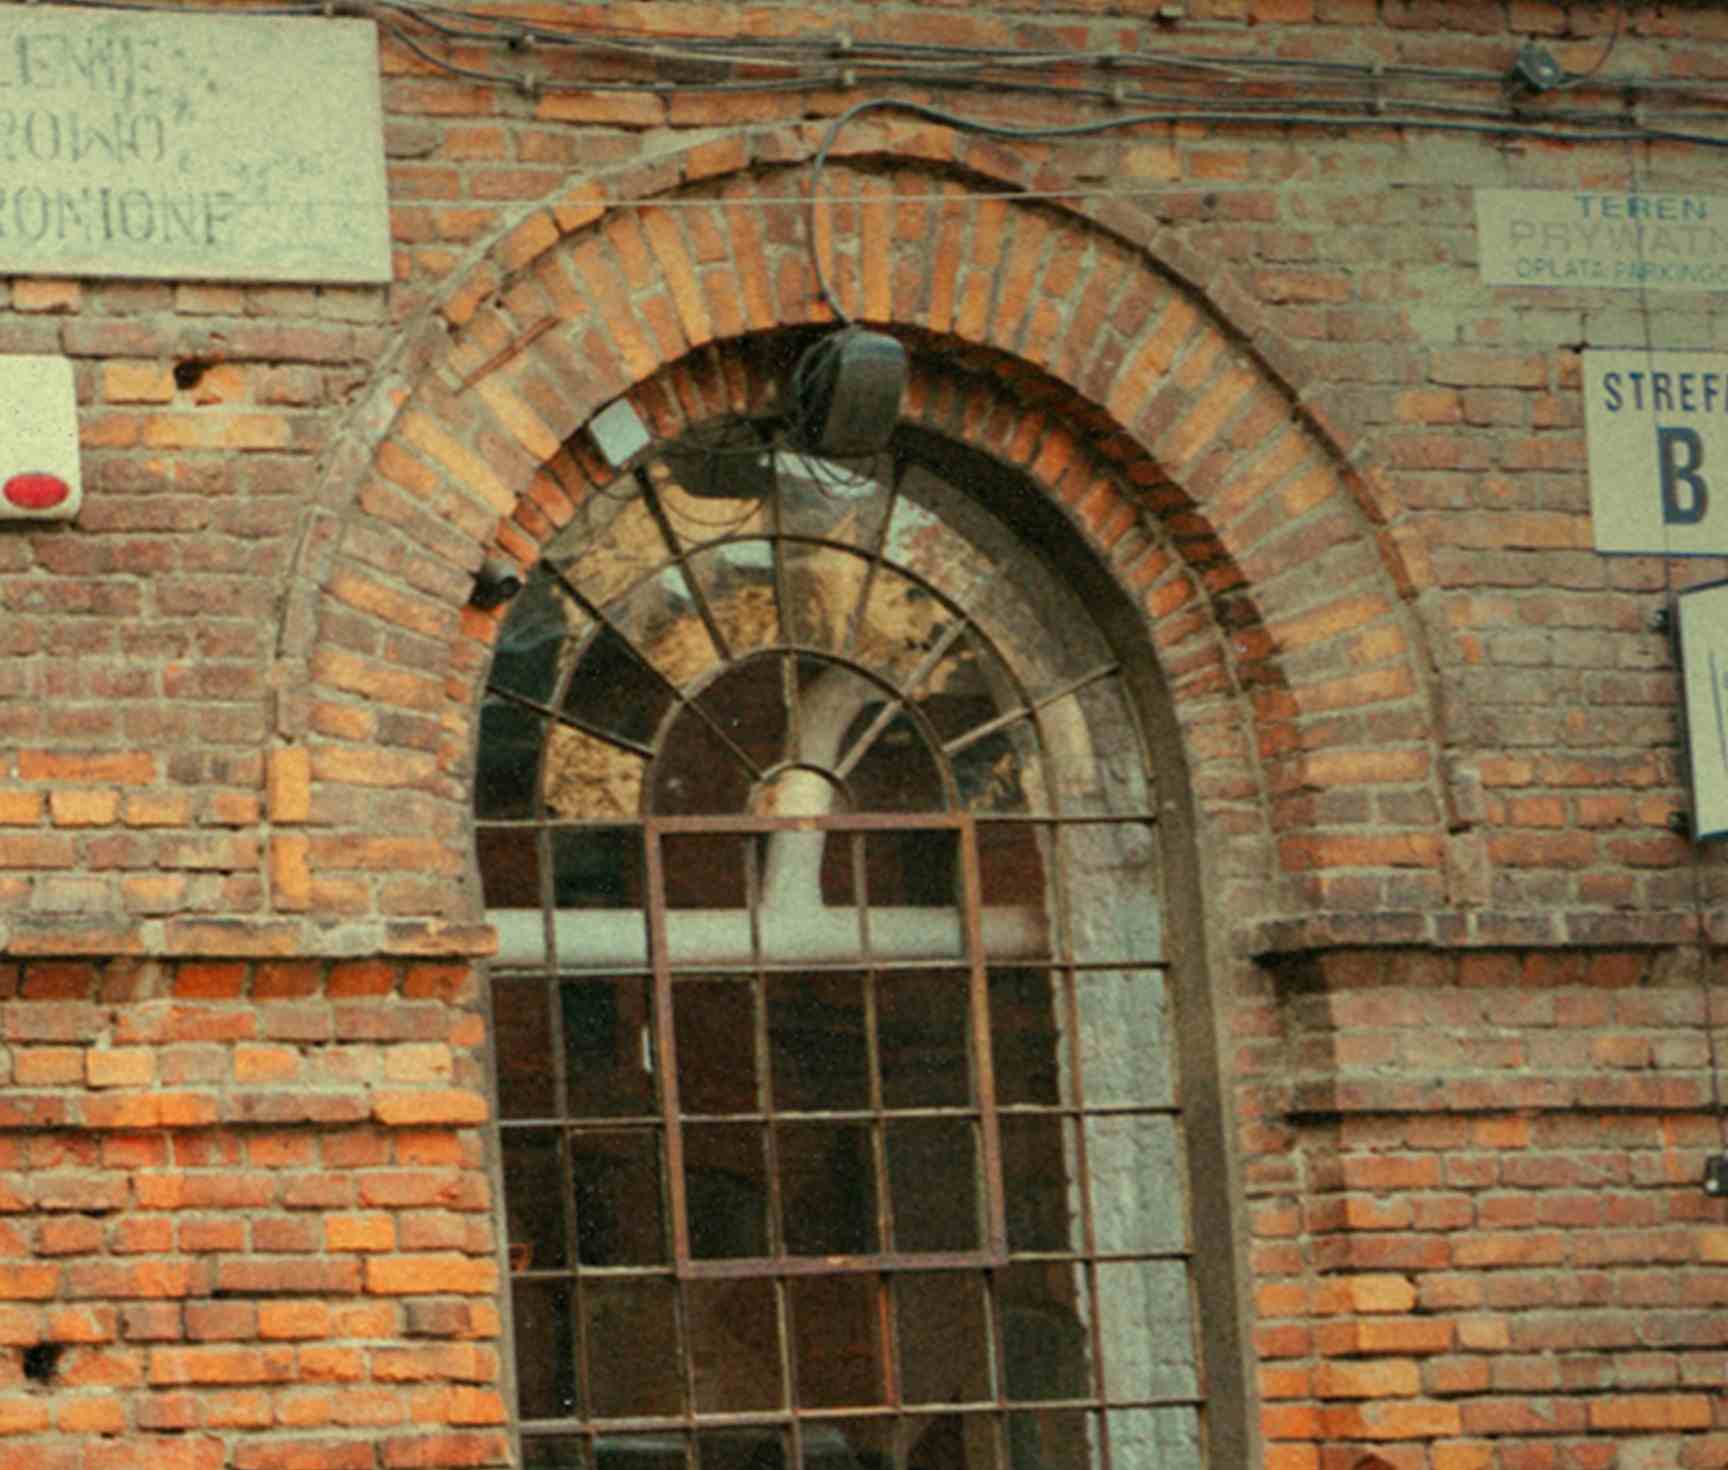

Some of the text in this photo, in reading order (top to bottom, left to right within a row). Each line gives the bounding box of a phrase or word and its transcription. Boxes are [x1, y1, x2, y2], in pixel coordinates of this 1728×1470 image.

[1575, 194, 1709, 220] TEREN
[1602, 370, 1728, 413] STREF
[1656, 425, 1709, 526] B
